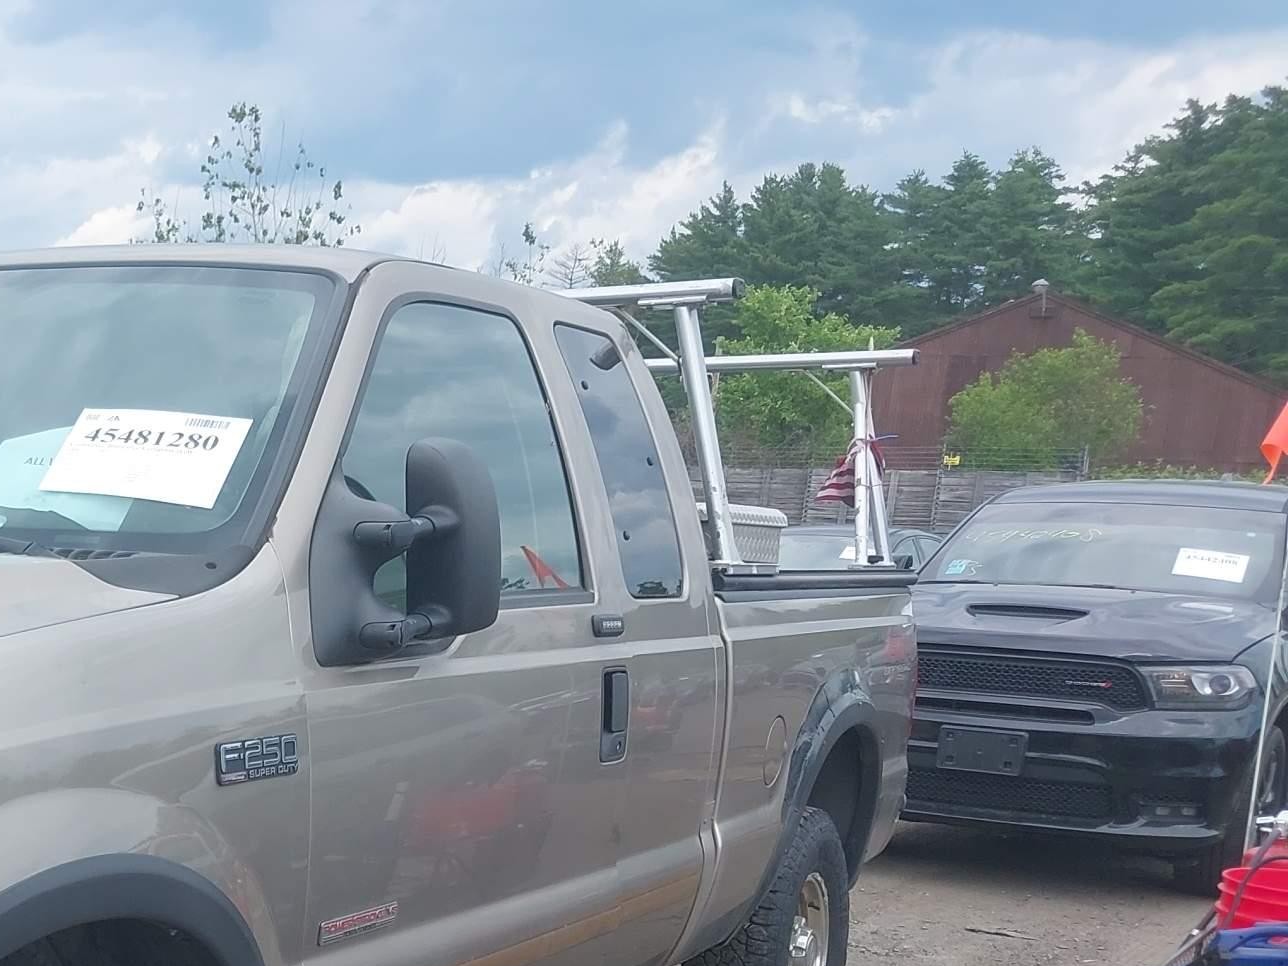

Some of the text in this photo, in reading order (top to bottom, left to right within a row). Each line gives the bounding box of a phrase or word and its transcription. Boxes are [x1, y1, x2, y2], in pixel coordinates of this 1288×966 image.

[84, 427, 219, 451] 45481280
[23, 457, 45, 466] ALL
[249, 762, 299, 778] SUPER DUTY
